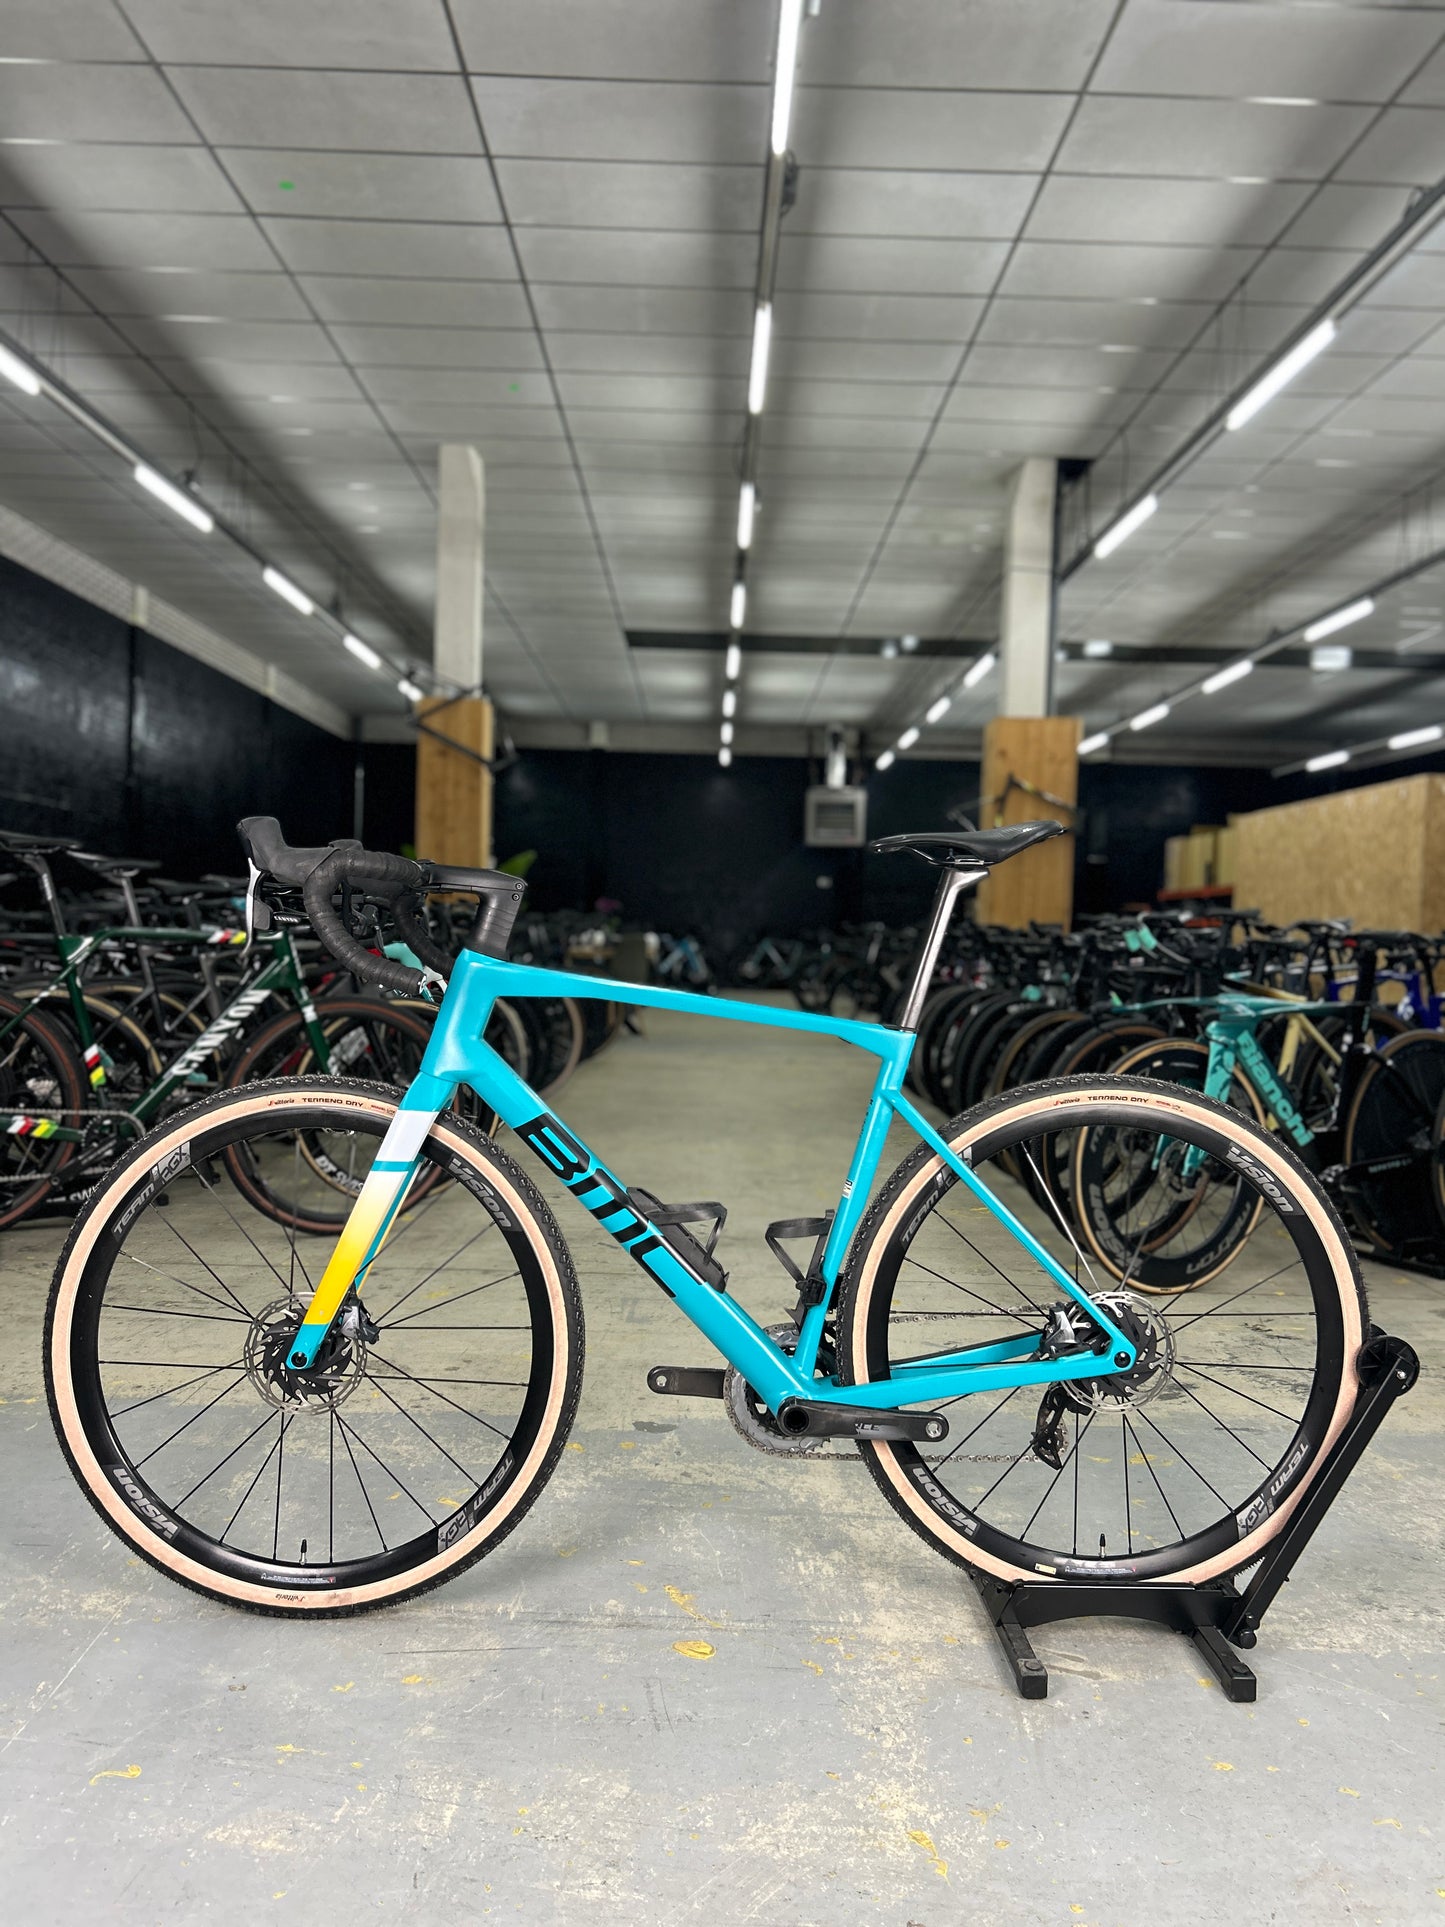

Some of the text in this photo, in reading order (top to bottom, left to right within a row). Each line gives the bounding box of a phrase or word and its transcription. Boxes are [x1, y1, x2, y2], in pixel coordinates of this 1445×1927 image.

[171, 989, 272, 1075] CANYON
[302, 1097, 343, 1105] TERRENO
[1237, 1029, 1315, 1147] Bianchi
[113, 1182, 155, 1234] TEAM
[513, 1111, 705, 1298] BMC
[902, 1189, 939, 1242] TEAM
[474, 1458, 513, 1511] TEAM
[1270, 1443, 1309, 1497] TEAM
